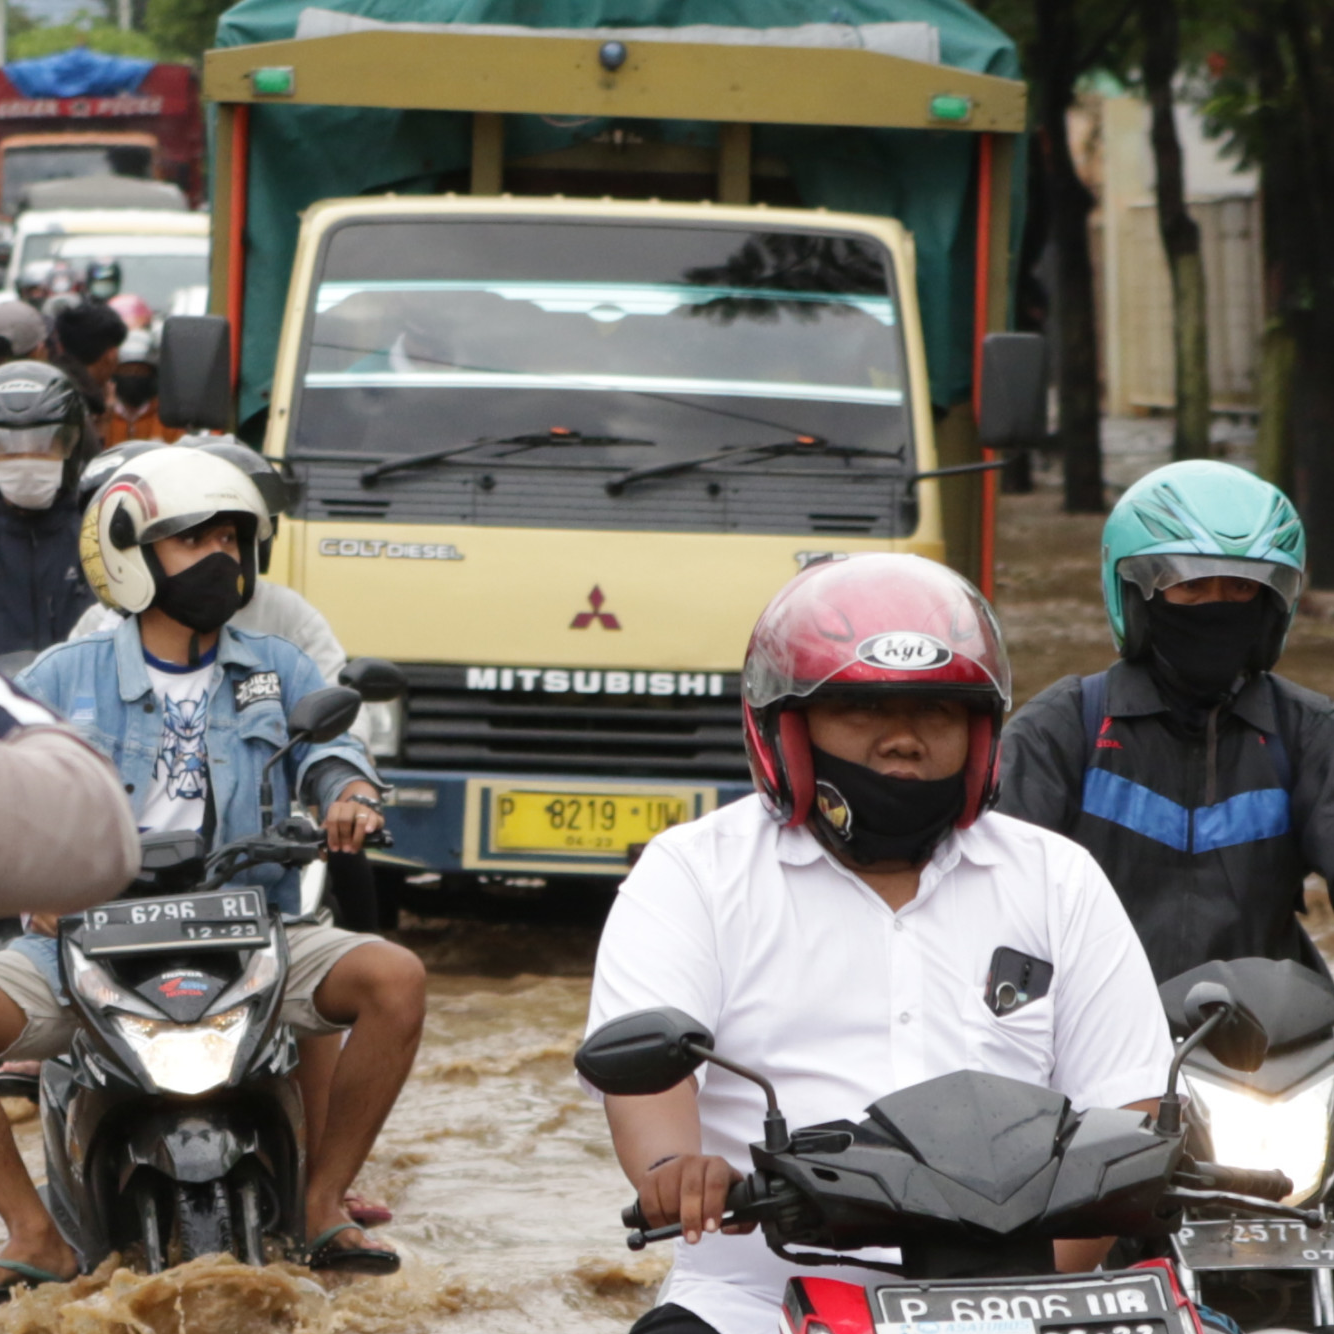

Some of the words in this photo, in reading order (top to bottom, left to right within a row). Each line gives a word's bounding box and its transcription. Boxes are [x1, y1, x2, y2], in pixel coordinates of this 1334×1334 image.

[319, 538, 386, 557] COLT
[386, 543, 466, 561] DIESEL
[466, 667, 724, 696] MITSUBISHI
[498, 797, 516, 829] P
[550, 799, 616, 831] 8219
[92, 911, 108, 931] P
[221, 895, 256, 918] RL
[1178, 1227, 1196, 1246] P
[1232, 1224, 1310, 1243] 2577
[899, 1297, 928, 1323] P
